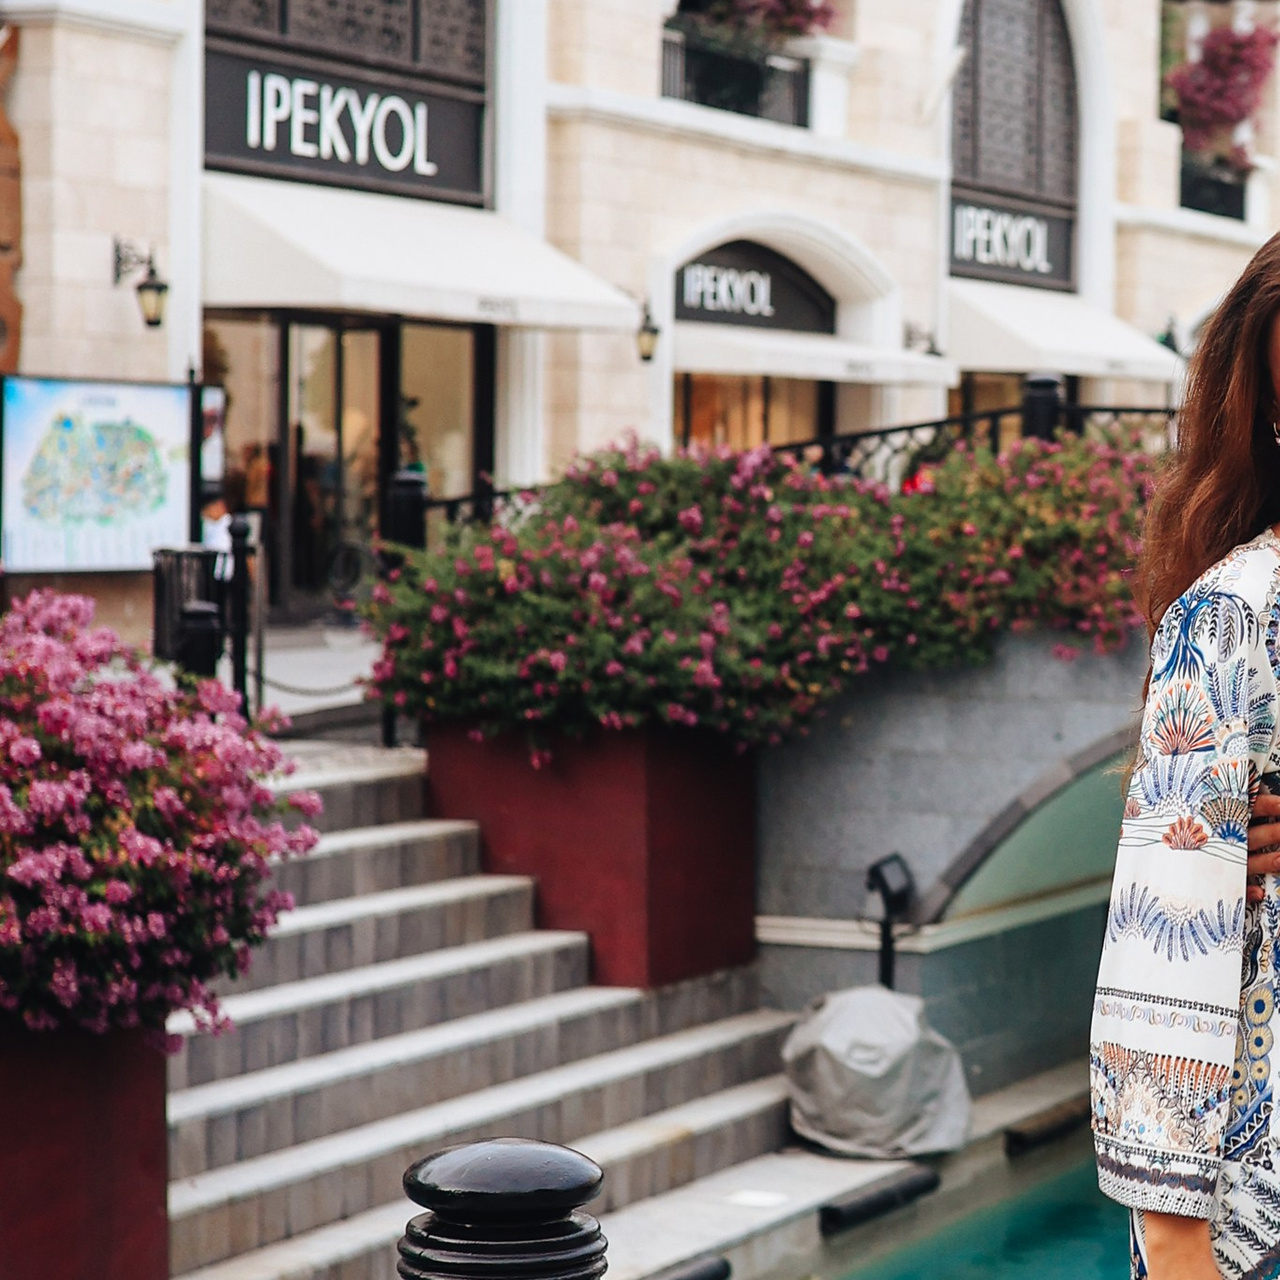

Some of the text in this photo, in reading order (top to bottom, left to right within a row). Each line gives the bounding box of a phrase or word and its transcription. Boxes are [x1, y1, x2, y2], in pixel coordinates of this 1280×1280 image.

[247, 69, 438, 176] IPEKYOL
[953, 205, 1053, 273] IPEKYOL
[683, 263, 775, 317] IPEKYOL
